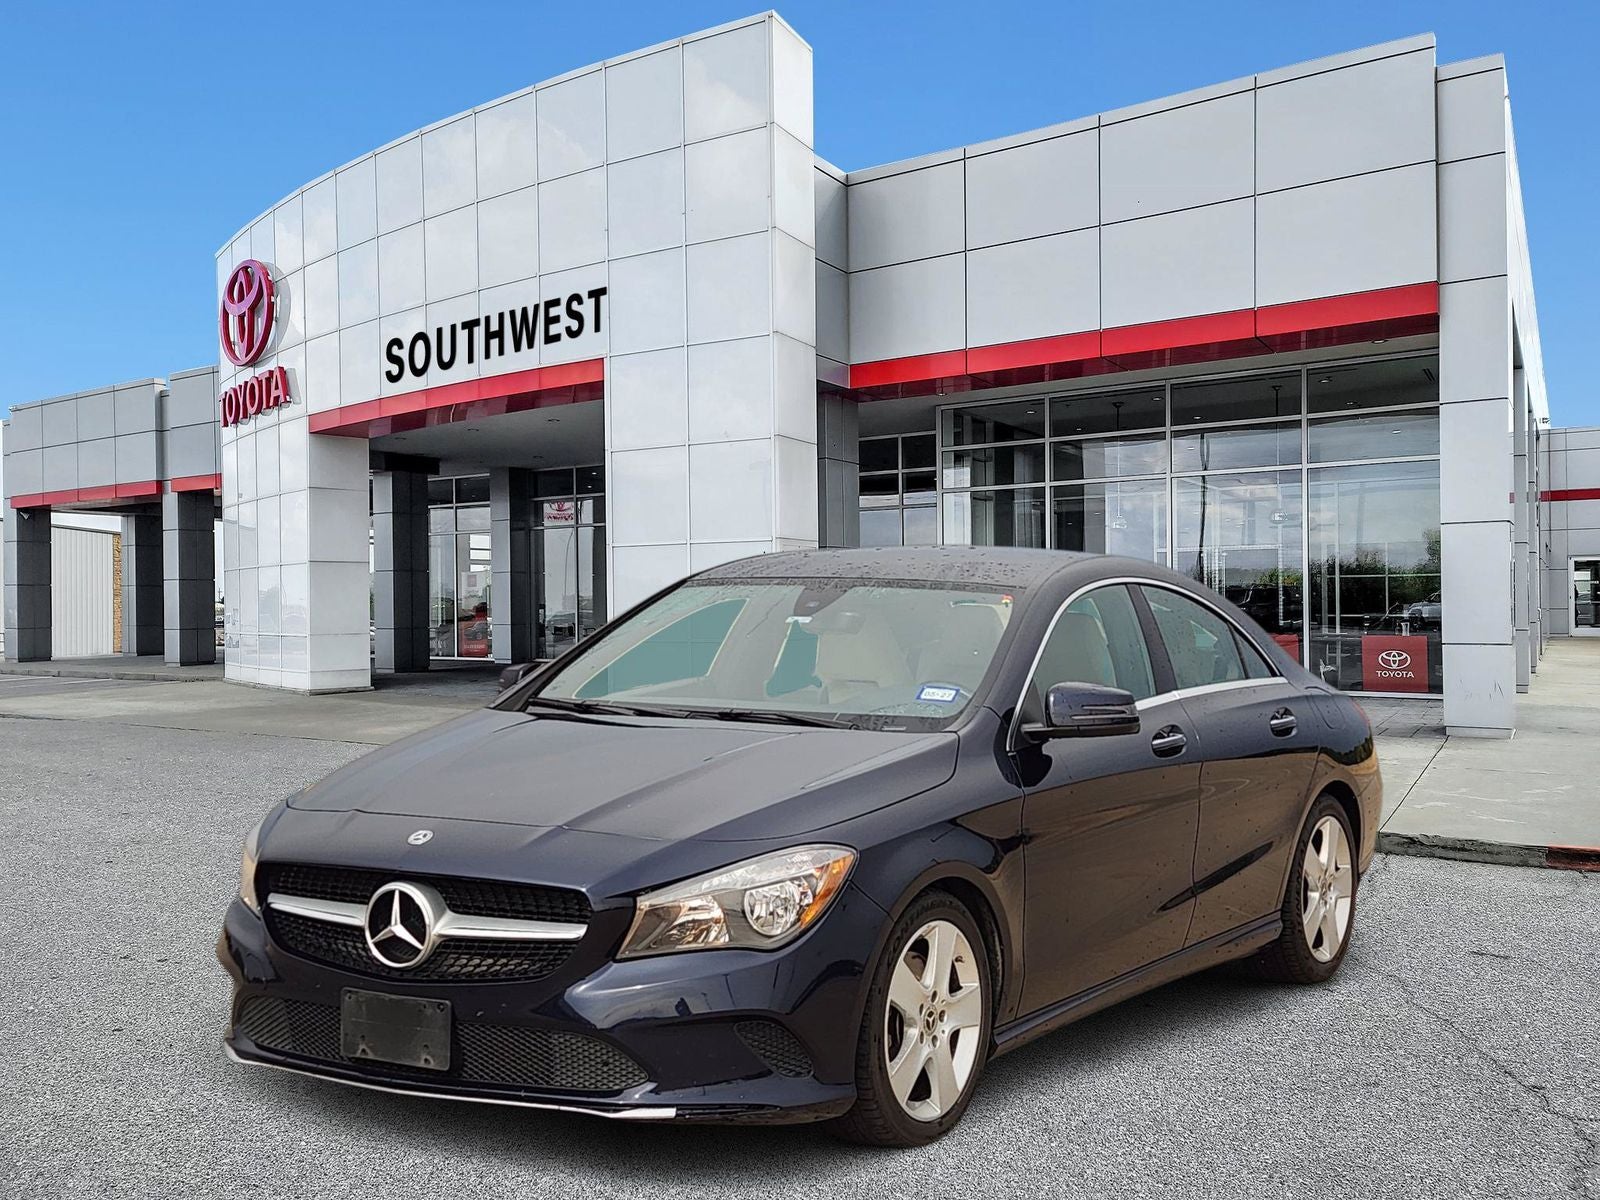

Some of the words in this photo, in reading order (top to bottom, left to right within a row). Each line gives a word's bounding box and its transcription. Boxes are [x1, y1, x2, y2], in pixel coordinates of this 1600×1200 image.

[385, 287, 608, 383] SOUTHWEST
[219, 366, 291, 428] TOYOTA
[1375, 670, 1415, 679] TOYOTA
